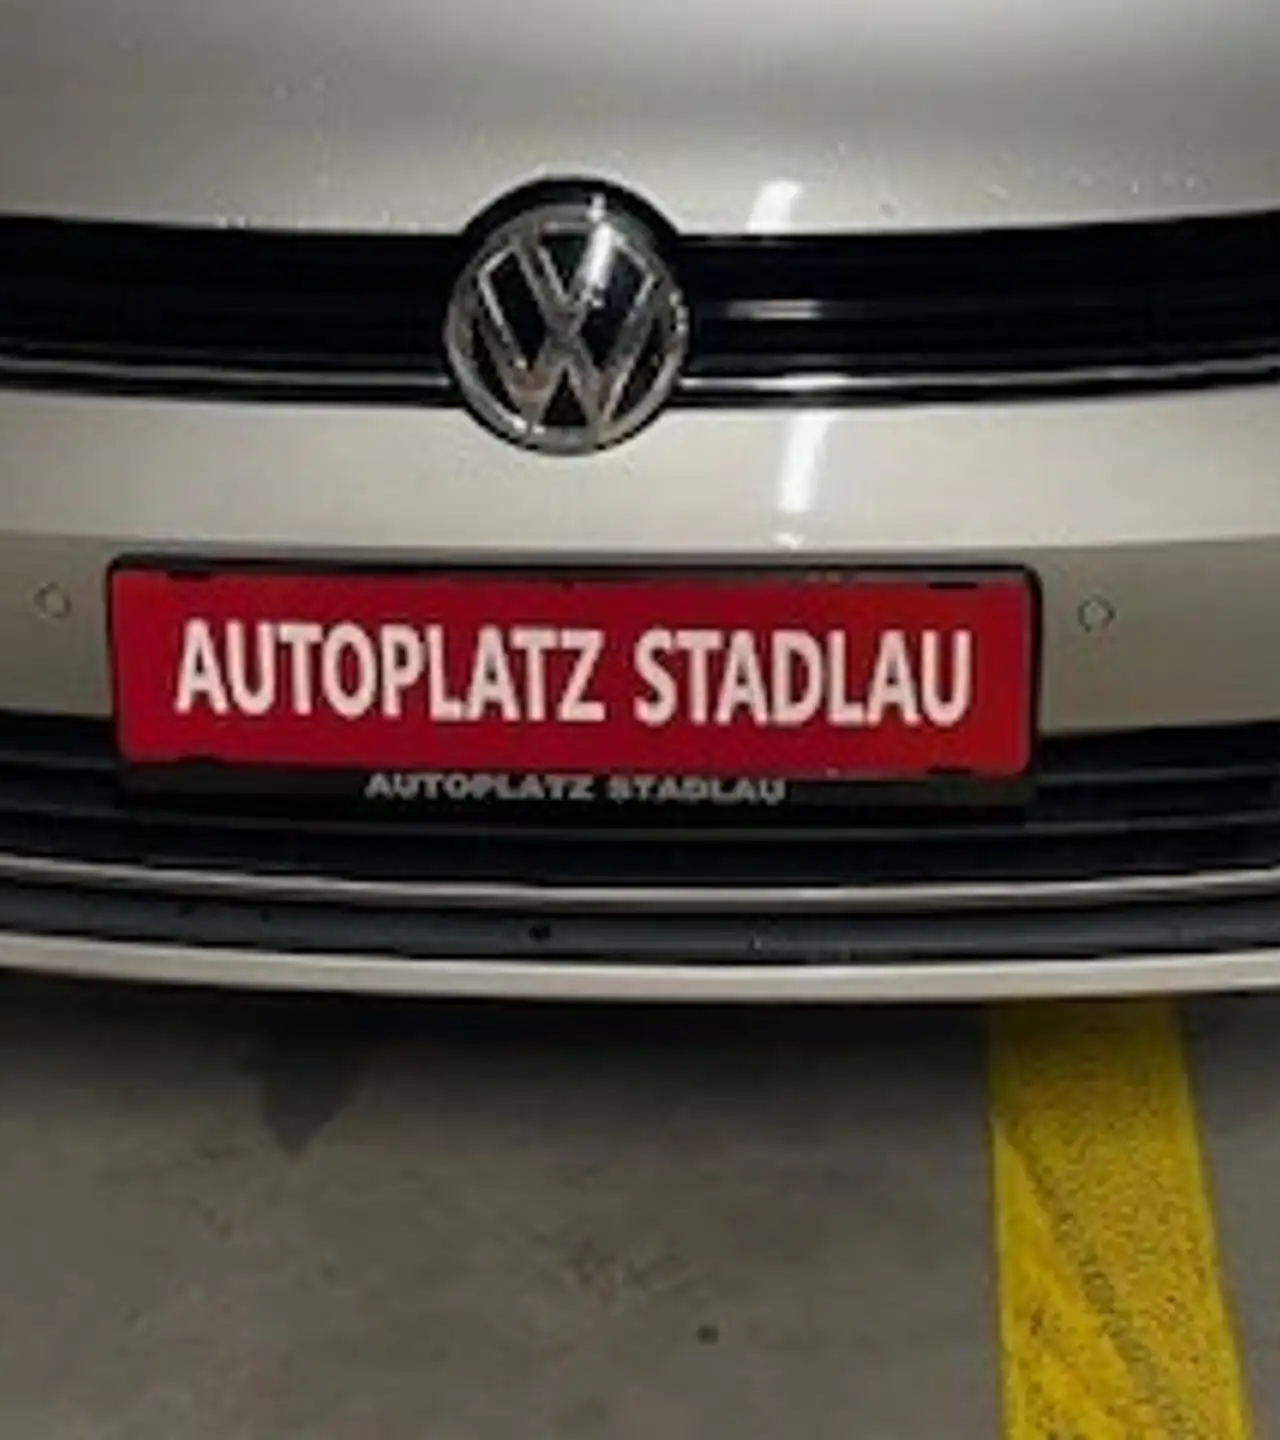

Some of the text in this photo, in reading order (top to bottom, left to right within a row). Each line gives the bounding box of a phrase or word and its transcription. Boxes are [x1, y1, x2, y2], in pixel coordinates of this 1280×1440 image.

[458, 210, 672, 444] VW
[174, 617, 973, 728] AUTOPLATZ STADLAU
[363, 771, 787, 803] AUTOPLATZ STADLAU
